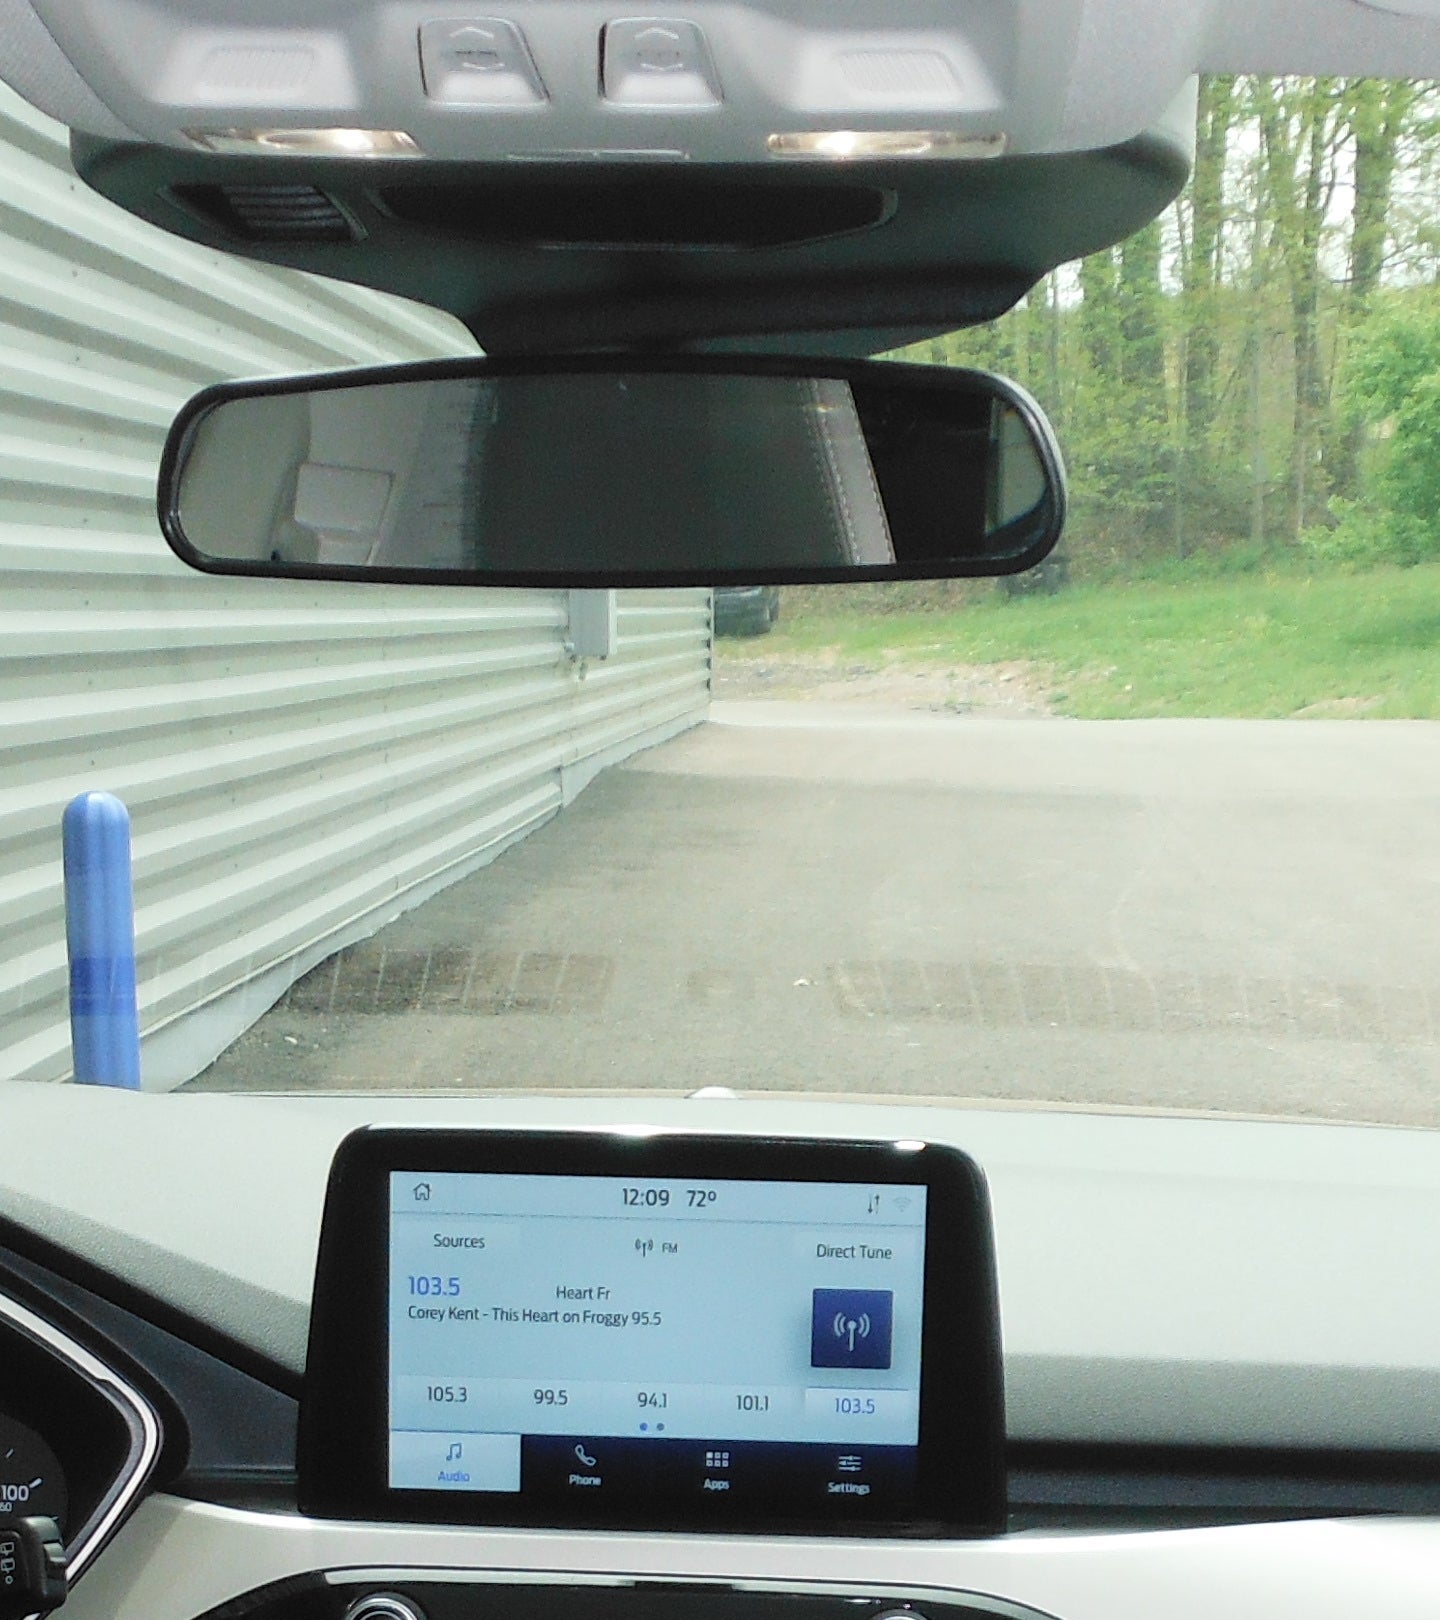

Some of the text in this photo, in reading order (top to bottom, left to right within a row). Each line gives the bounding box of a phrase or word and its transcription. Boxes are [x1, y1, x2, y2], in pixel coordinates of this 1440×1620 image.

[621, 1187, 670, 1206] 12:09
[433, 1233, 486, 1249] Sources
[662, 1242, 678, 1253] FM
[816, 1243, 892, 1260] Direct Tune
[408, 1275, 461, 1297] 103.5
[556, 1285, 611, 1300] Heart Fr
[408, 1305, 446, 1322] Corey
[448, 1306, 480, 1321] Kent
[492, 1307, 519, 1322] This
[522, 1308, 559, 1323] Heart
[562, 1311, 580, 1324] on
[582, 1309, 628, 1327] Froggy
[631, 1310, 662, 1326] 95.5
[427, 1386, 468, 1403] 105.3
[533, 1388, 569, 1406] 99.5
[637, 1391, 668, 1409] 94.1
[736, 1394, 770, 1411] 101.1
[835, 1397, 876, 1415] 103.5
[437, 1470, 471, 1483] Audio
[568, 1474, 602, 1486] Phone
[703, 1478, 730, 1491] Apps
[0, 1484, 29, 1502] 100
[827, 1481, 871, 1496] Settings
